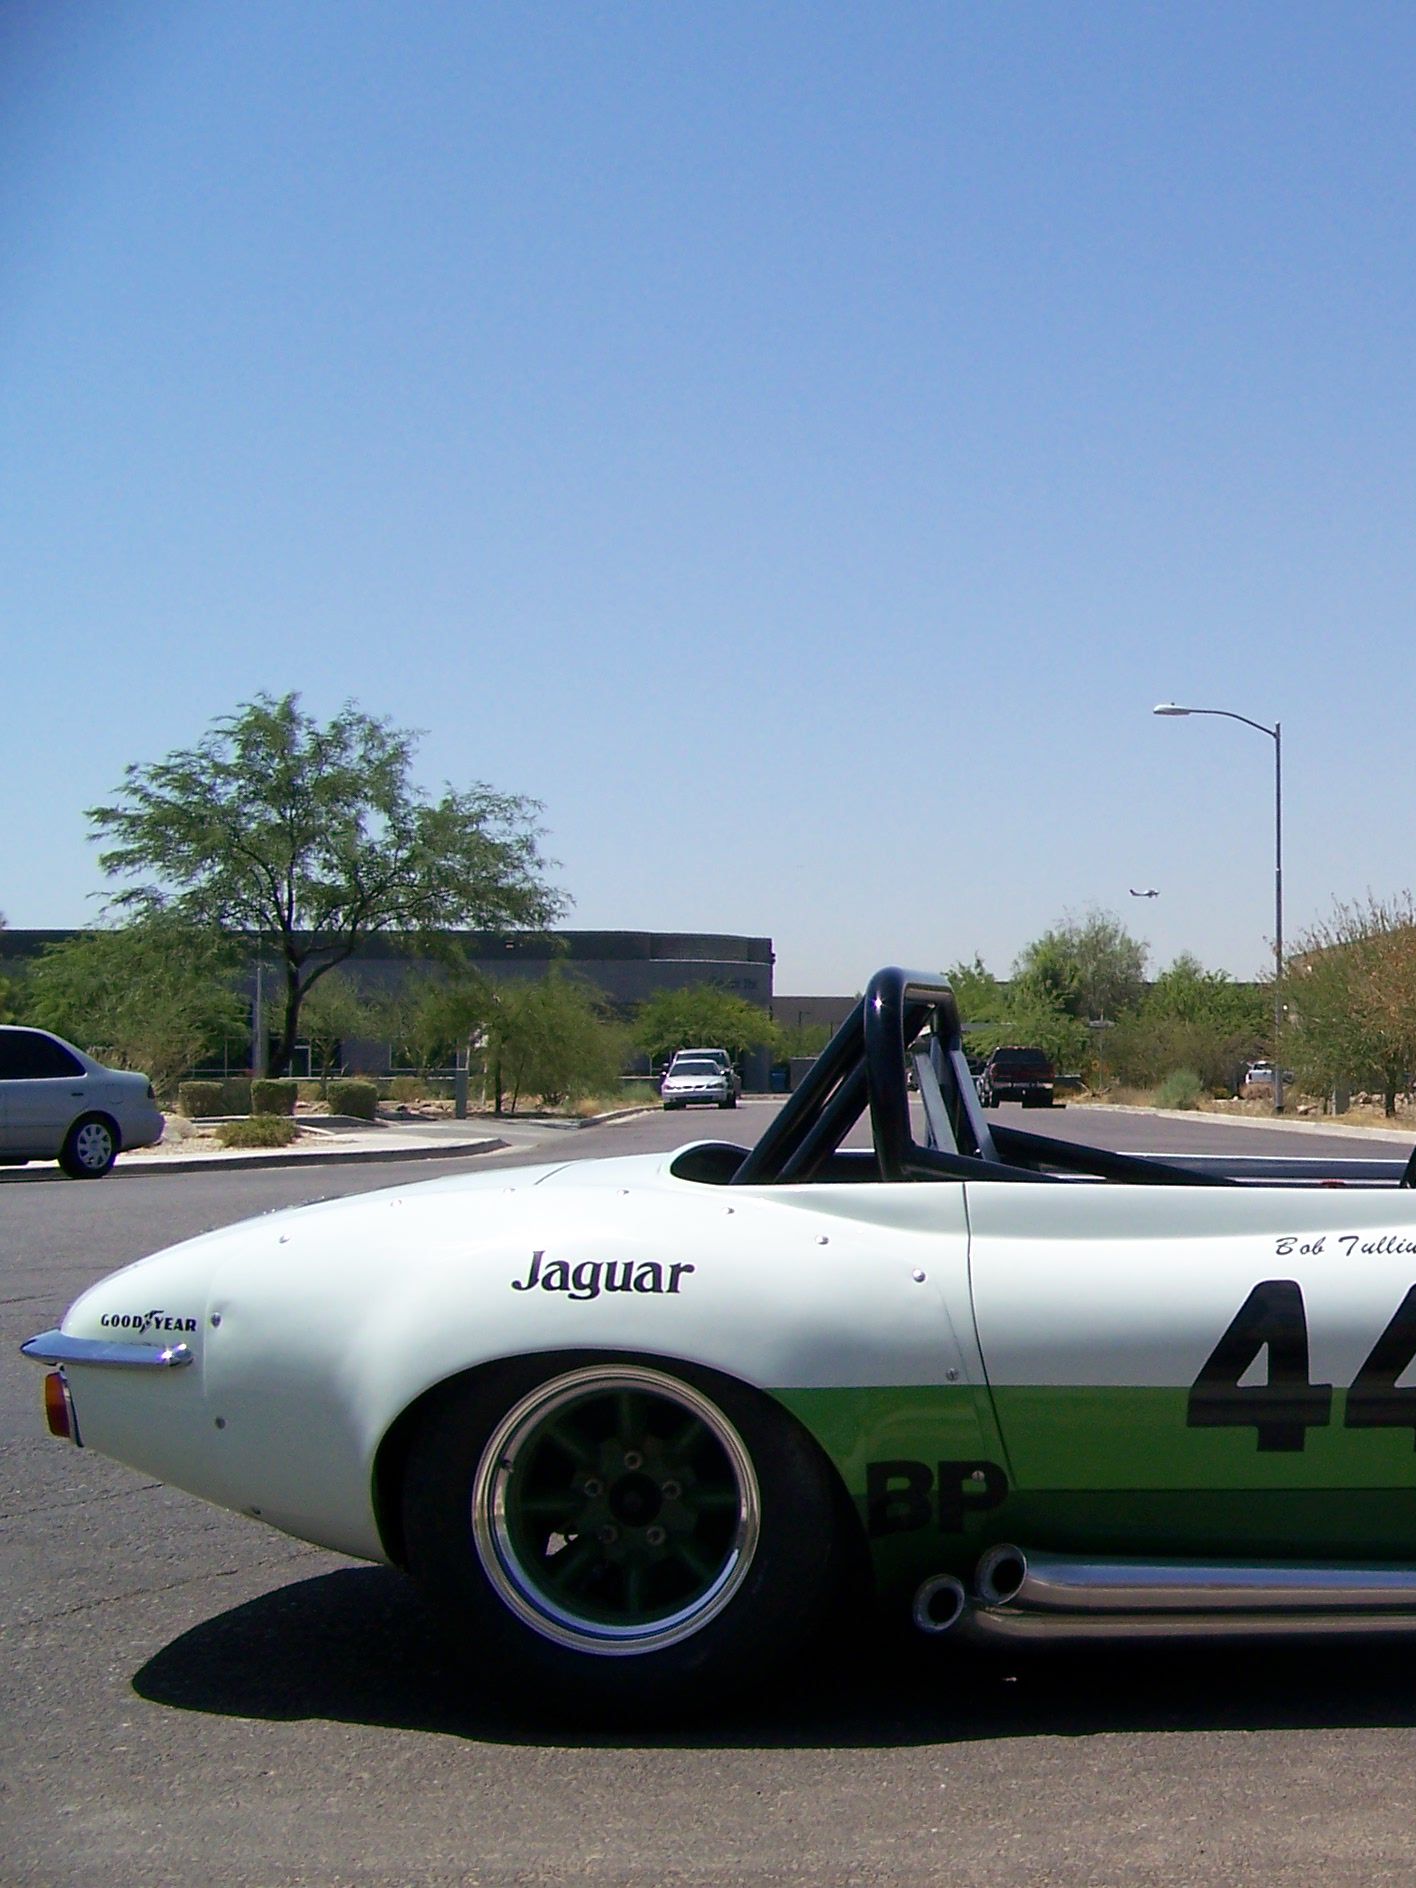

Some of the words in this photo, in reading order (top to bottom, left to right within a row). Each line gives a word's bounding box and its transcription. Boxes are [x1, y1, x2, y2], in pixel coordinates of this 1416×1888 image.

[1276, 1236, 1326, 1256] Bob
[511, 1249, 696, 1300] Jaguar
[866, 1460, 1010, 1537] BP
